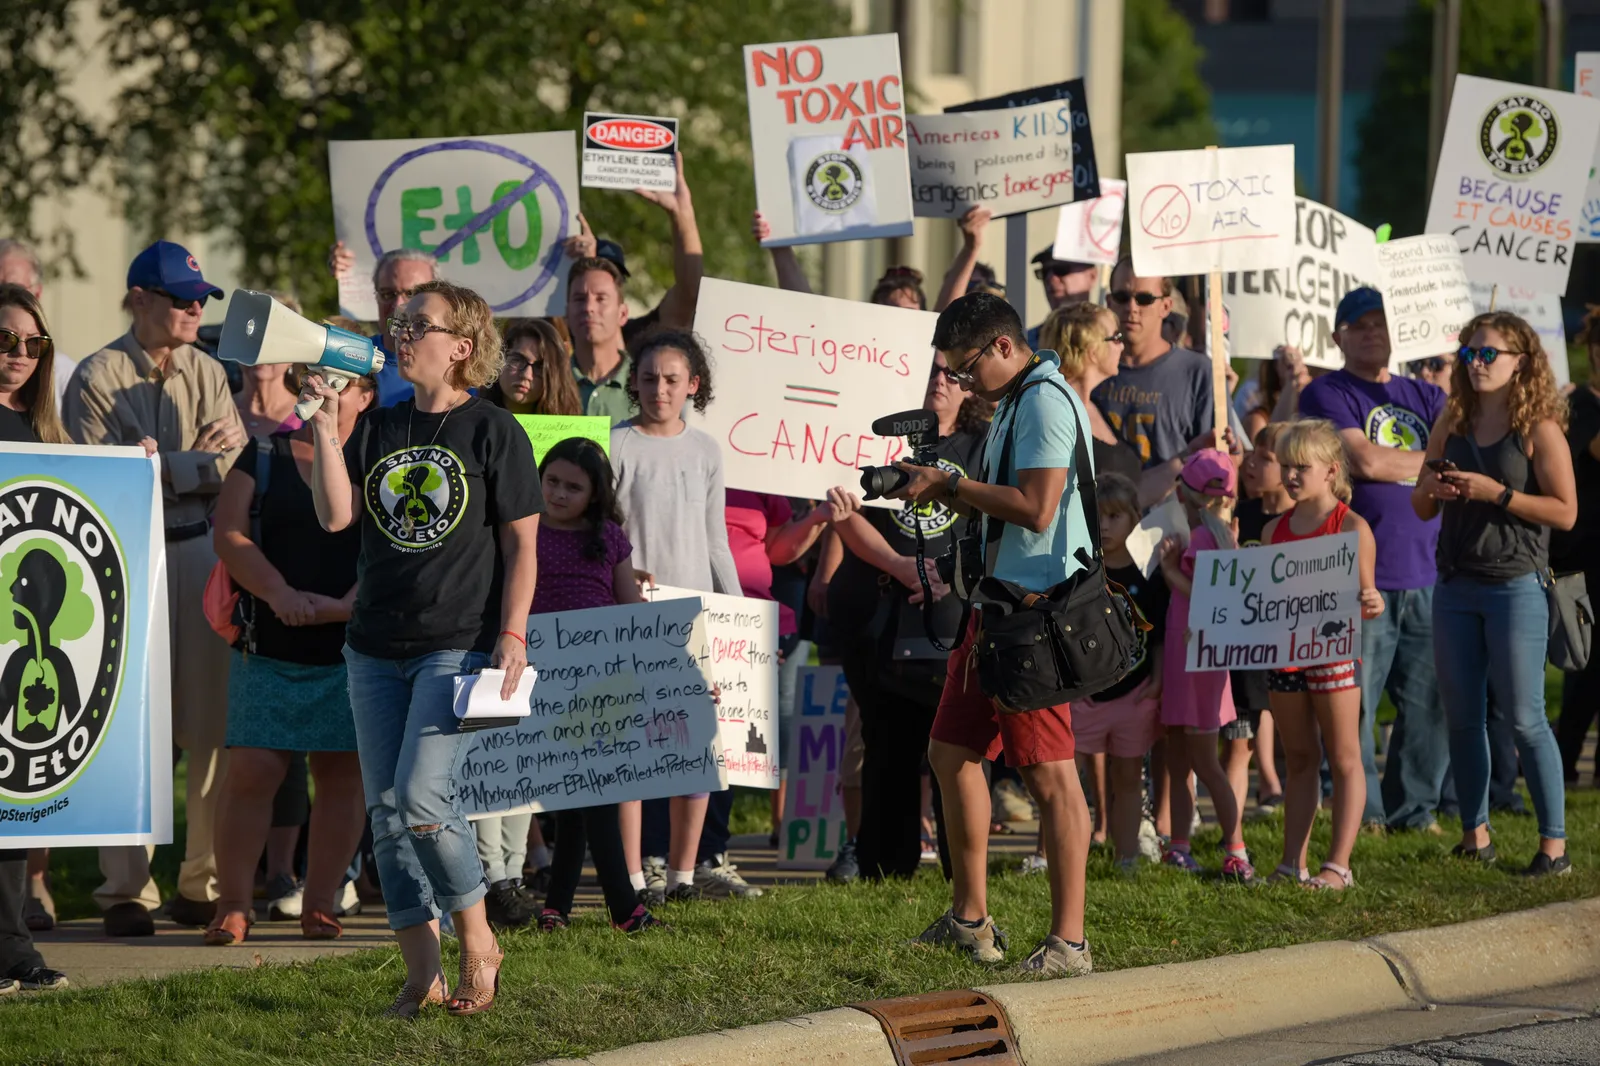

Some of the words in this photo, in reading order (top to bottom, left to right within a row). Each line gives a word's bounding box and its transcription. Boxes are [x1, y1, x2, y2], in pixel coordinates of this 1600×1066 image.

[752, 45, 823, 87] NO
[777, 75, 902, 125] TOXIC
[1497, 96, 1528, 112] SAY
[1530, 100, 1551, 120] NO
[595, 124, 668, 144] DANGER
[840, 114, 905, 151] AIR
[584, 152, 639, 166] ETHYLENE
[642, 156, 675, 168] OXIDE
[597, 166, 628, 175] CANCER
[630, 167, 661, 176] HAZARD
[917, 155, 955, 175] being
[974, 145, 1045, 175] poisoned
[1054, 143, 1070, 162] by
[911, 178, 999, 213] terigenics
[1004, 172, 1041, 198] toxic
[1042, 169, 1074, 198] gas
[1189, 174, 1274, 203] TOXIC
[1458, 176, 1562, 216] BECAUSE
[1160, 213, 1182, 234] NO
[1211, 206, 1262, 232] AIR
[1294, 201, 1347, 255] TOP
[1453, 201, 1482, 220] IT
[1488, 206, 1573, 241] CAUSES
[1450, 225, 1569, 266] CANCER
[722, 314, 910, 377] Sterigenics
[728, 412, 904, 470] CANCER
[892, 418, 929, 434] RØDE
[385, 451, 425, 468] SAY
[428, 450, 453, 467] NO
[0, 493, 39, 537] AY
[52, 497, 103, 557] NO
[387, 518, 409, 539] TO
[416, 519, 449, 541] EtO
[920, 514, 948, 530] EtO
[1210, 558, 1256, 594] My
[1270, 542, 1356, 584] Community
[556, 617, 609, 650] been
[615, 614, 694, 648] inhaling
[734, 612, 764, 630] more
[1212, 606, 1227, 624] is
[605, 653, 628, 675] at
[633, 652, 683, 675] home,
[687, 644, 710, 668] at
[712, 637, 750, 664] CANCER
[747, 640, 772, 670] than
[1197, 629, 1278, 668] human
[736, 672, 748, 693] to
[801, 673, 851, 716] LE
[532, 697, 566, 717] the
[568, 685, 647, 719] playground
[656, 683, 708, 700] since
[728, 706, 745, 718] one
[748, 698, 769, 721] has
[481, 731, 514, 754] was
[515, 725, 548, 748] born
[553, 721, 585, 742] and
[591, 720, 611, 738] no
[615, 714, 650, 732] one
[653, 706, 689, 727] has
[0, 747, 15, 779] O
[28, 726, 89, 787] EtO
[461, 757, 509, 781] done
[516, 749, 579, 775] anything
[600, 736, 641, 757] stop
[798, 724, 847, 774] M
